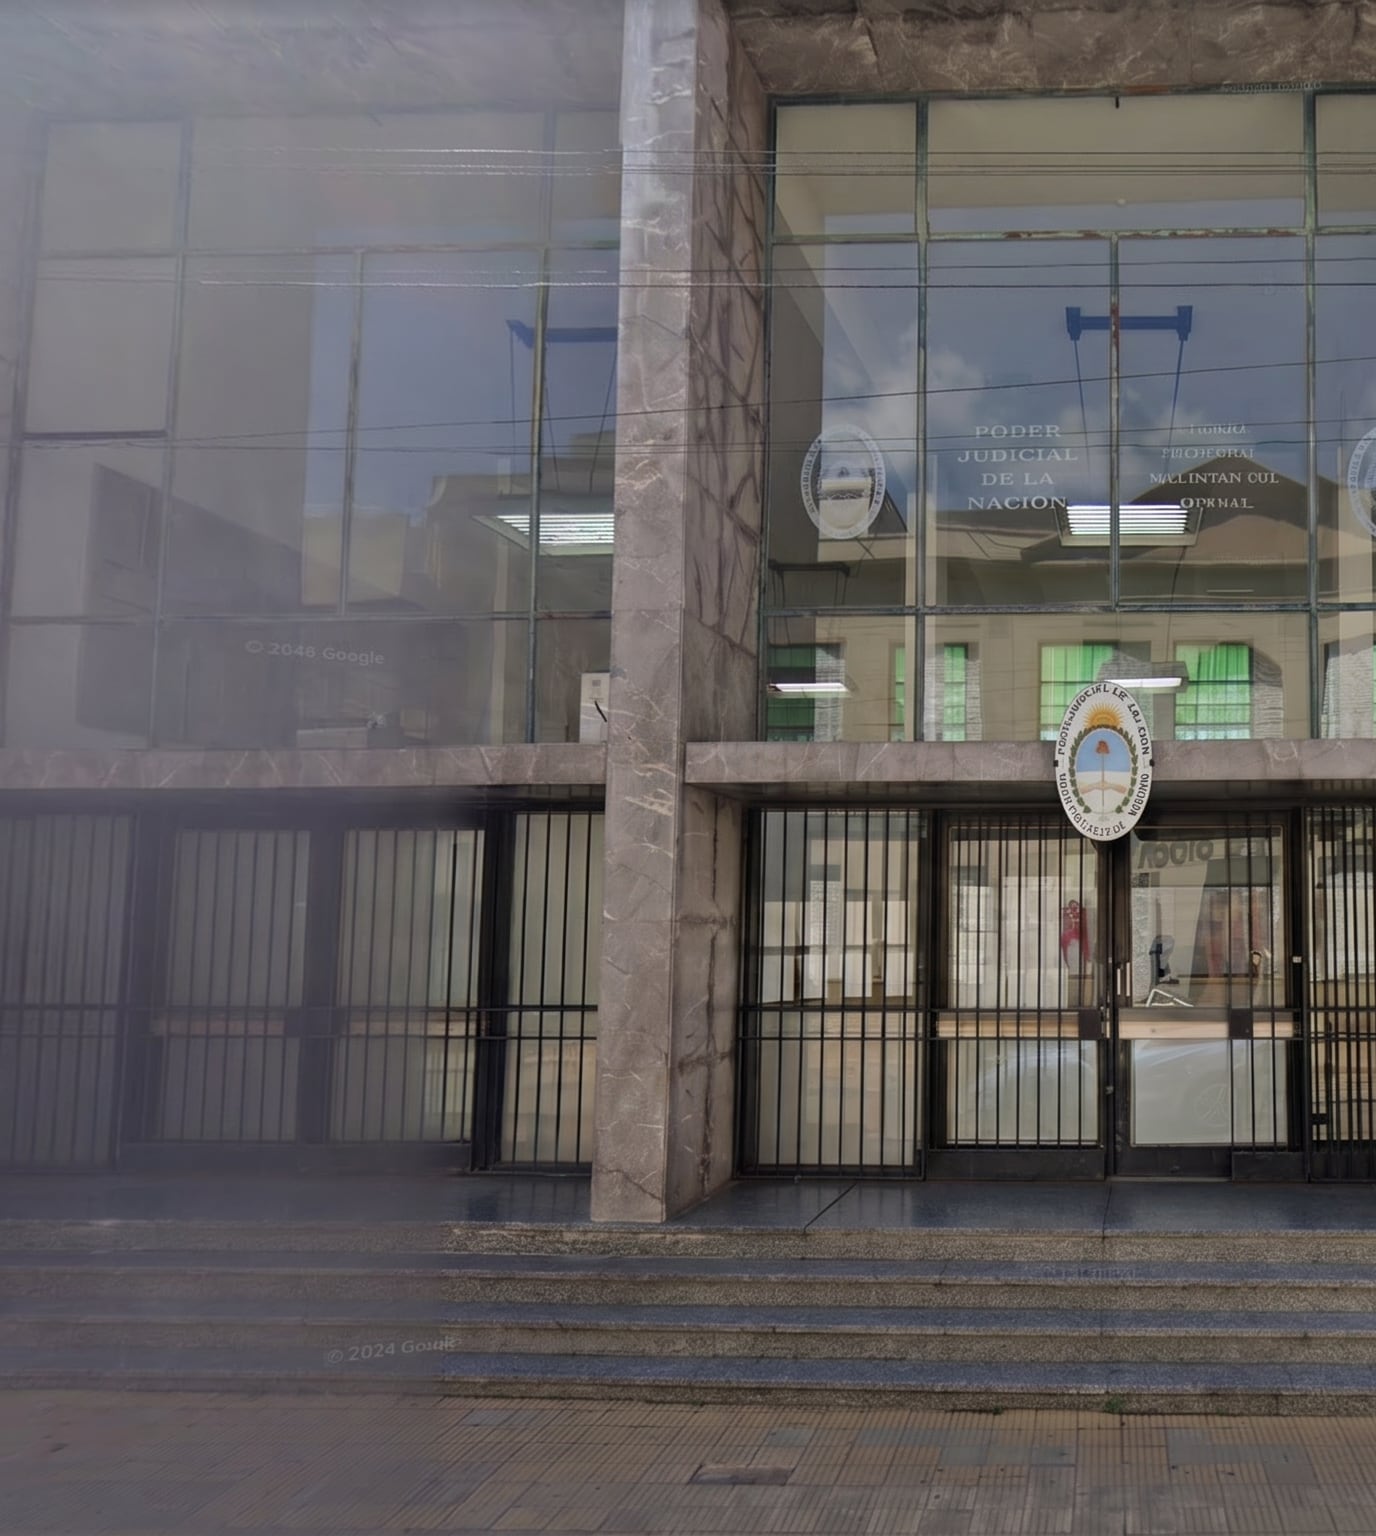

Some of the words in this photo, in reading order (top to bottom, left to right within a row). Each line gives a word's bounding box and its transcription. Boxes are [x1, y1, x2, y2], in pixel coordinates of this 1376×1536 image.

[974, 424, 1062, 439] PODER
[957, 448, 1080, 463] JUDICIAL
[981, 472, 1015, 486] DE
[1023, 472, 1055, 486] LA
[967, 495, 1067, 510] NACION
